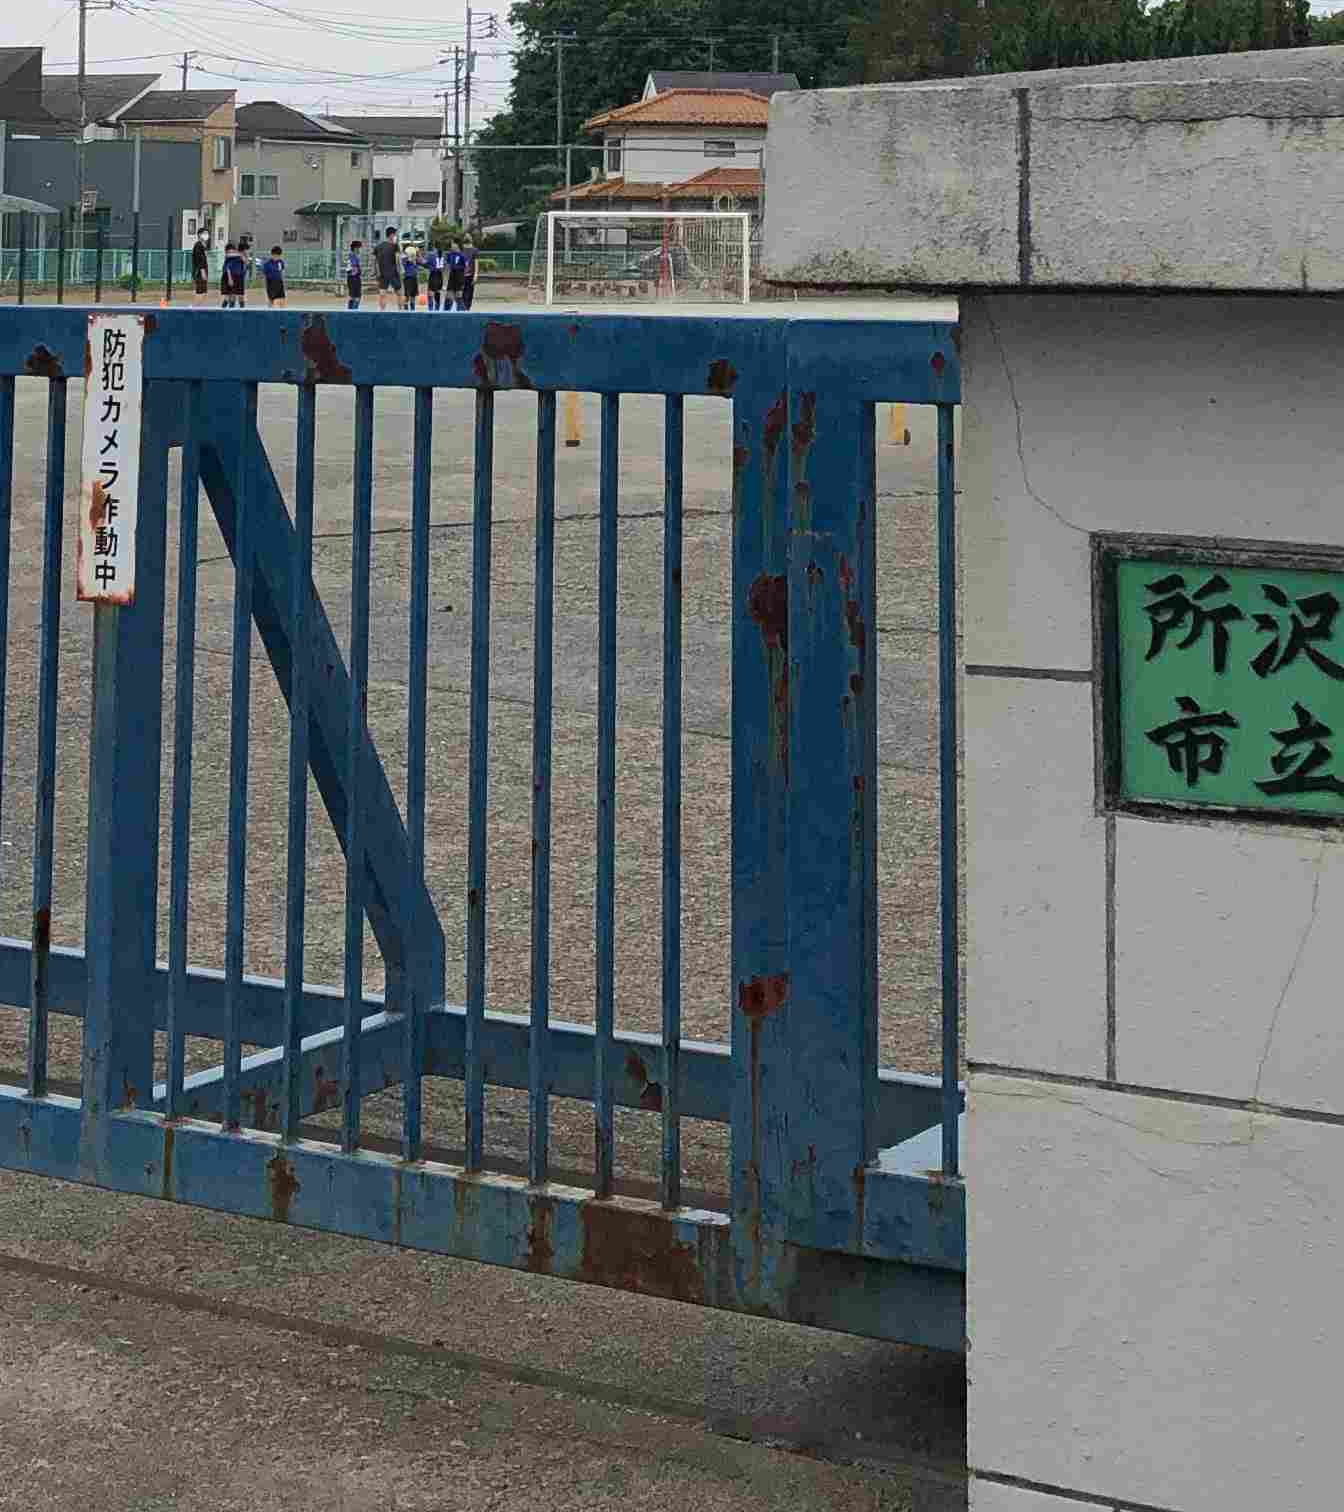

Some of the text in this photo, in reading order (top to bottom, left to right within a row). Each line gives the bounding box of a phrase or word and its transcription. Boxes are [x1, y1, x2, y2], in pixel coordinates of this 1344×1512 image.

[92, 328, 127, 590] 防犯カメラ作動中
